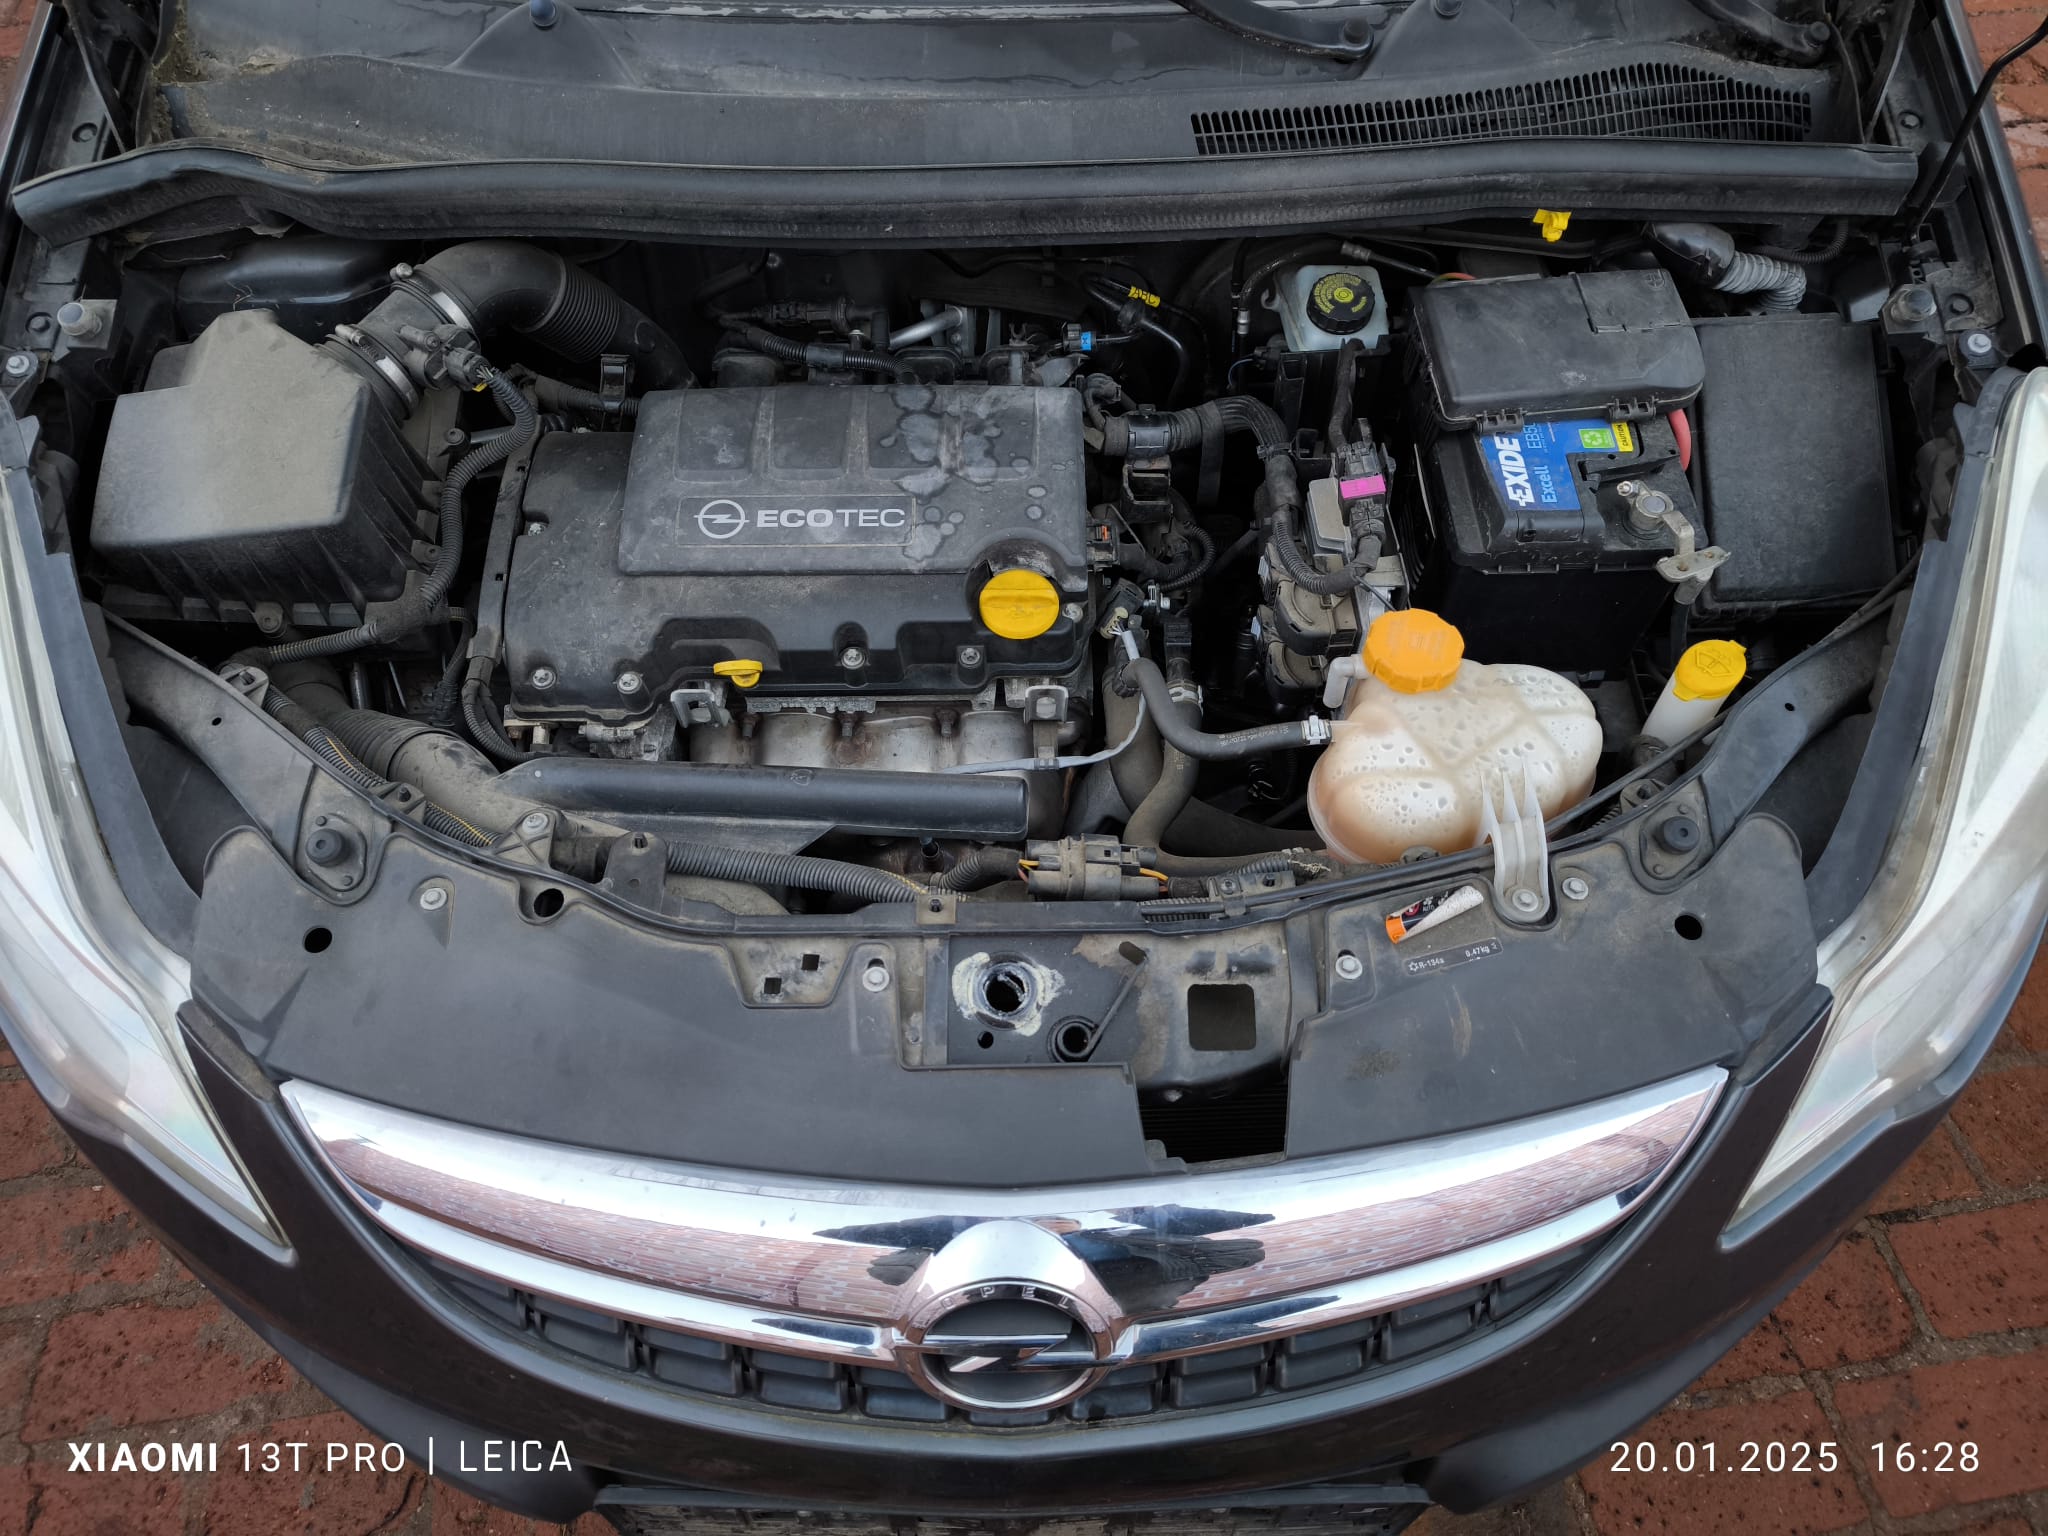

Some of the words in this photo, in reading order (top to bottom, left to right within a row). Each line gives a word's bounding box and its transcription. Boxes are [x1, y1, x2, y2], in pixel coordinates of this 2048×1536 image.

[1494, 433, 1535, 507] EXIDE
[1534, 465, 1557, 503] Excell
[757, 508, 905, 527] ECOTEC
[1418, 957, 1445, 969] R-134a
[940, 1285, 1070, 1310] OPEL
